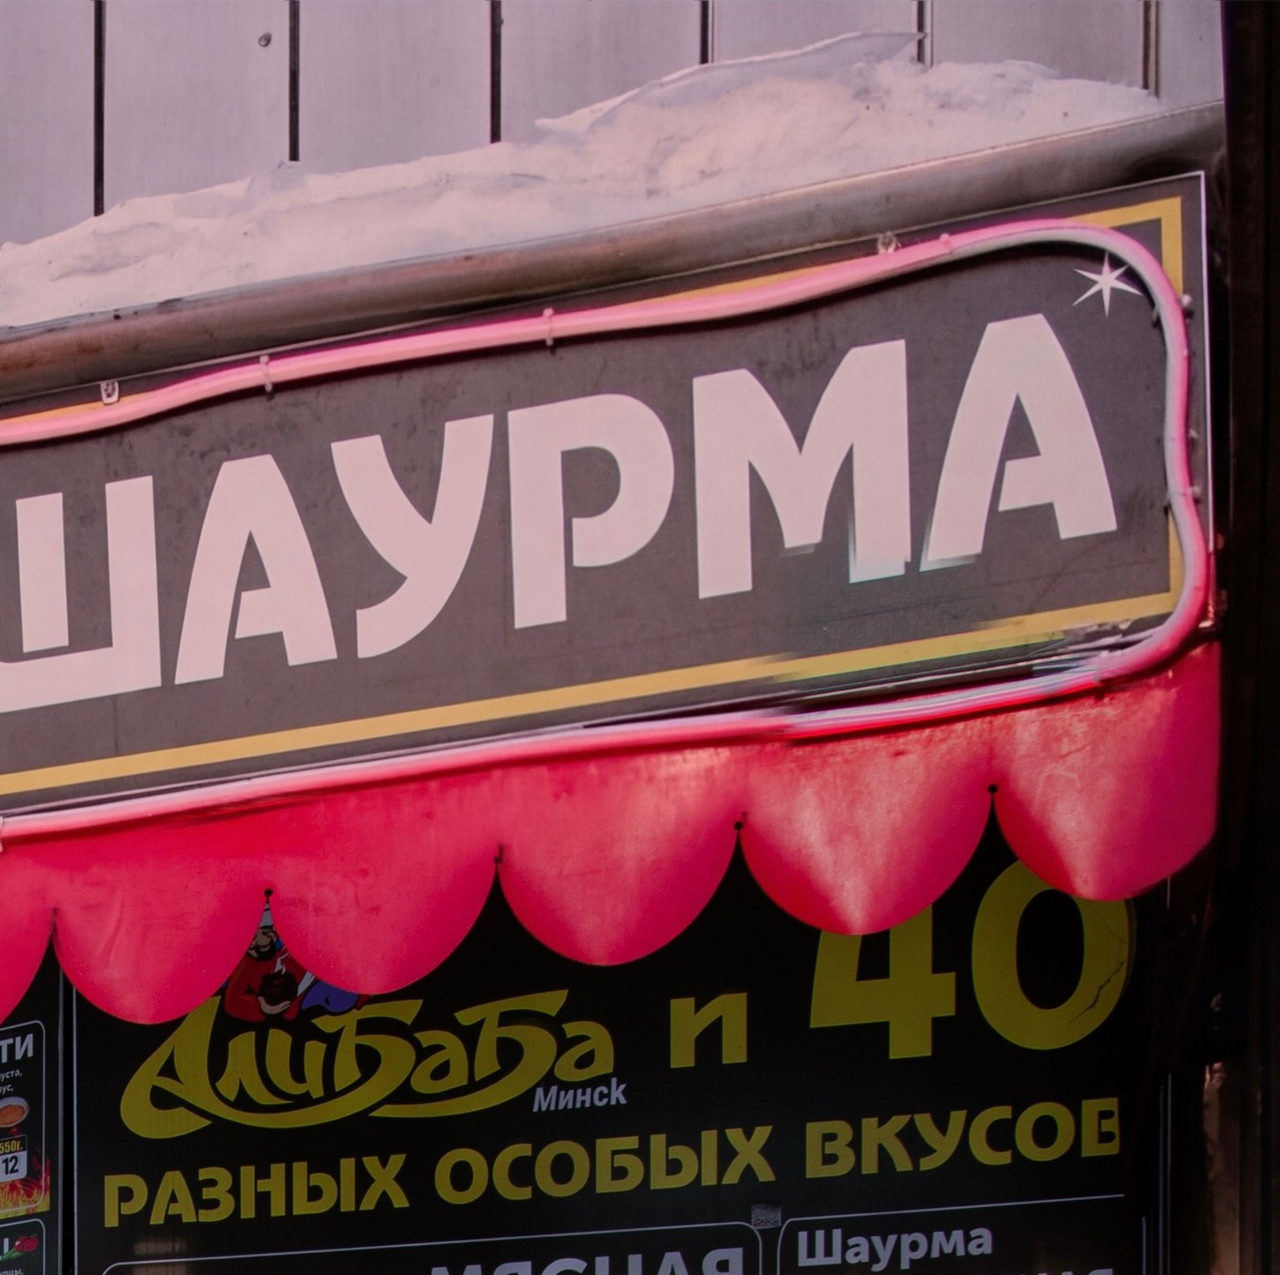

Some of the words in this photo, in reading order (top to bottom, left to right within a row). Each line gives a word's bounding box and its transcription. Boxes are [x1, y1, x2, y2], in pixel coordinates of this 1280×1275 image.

[808, 861, 1135, 1061] 40
[532, 1076, 628, 1114] Минск
[1, 1154, 19, 1175] 12
[103, 1153, 410, 1228] РАЗНЫХ
[434, 1125, 776, 1204] ОСОБЫХ
[805, 1097, 1119, 1178] ВКУСОВ
[797, 1226, 993, 1270] Шаурма
